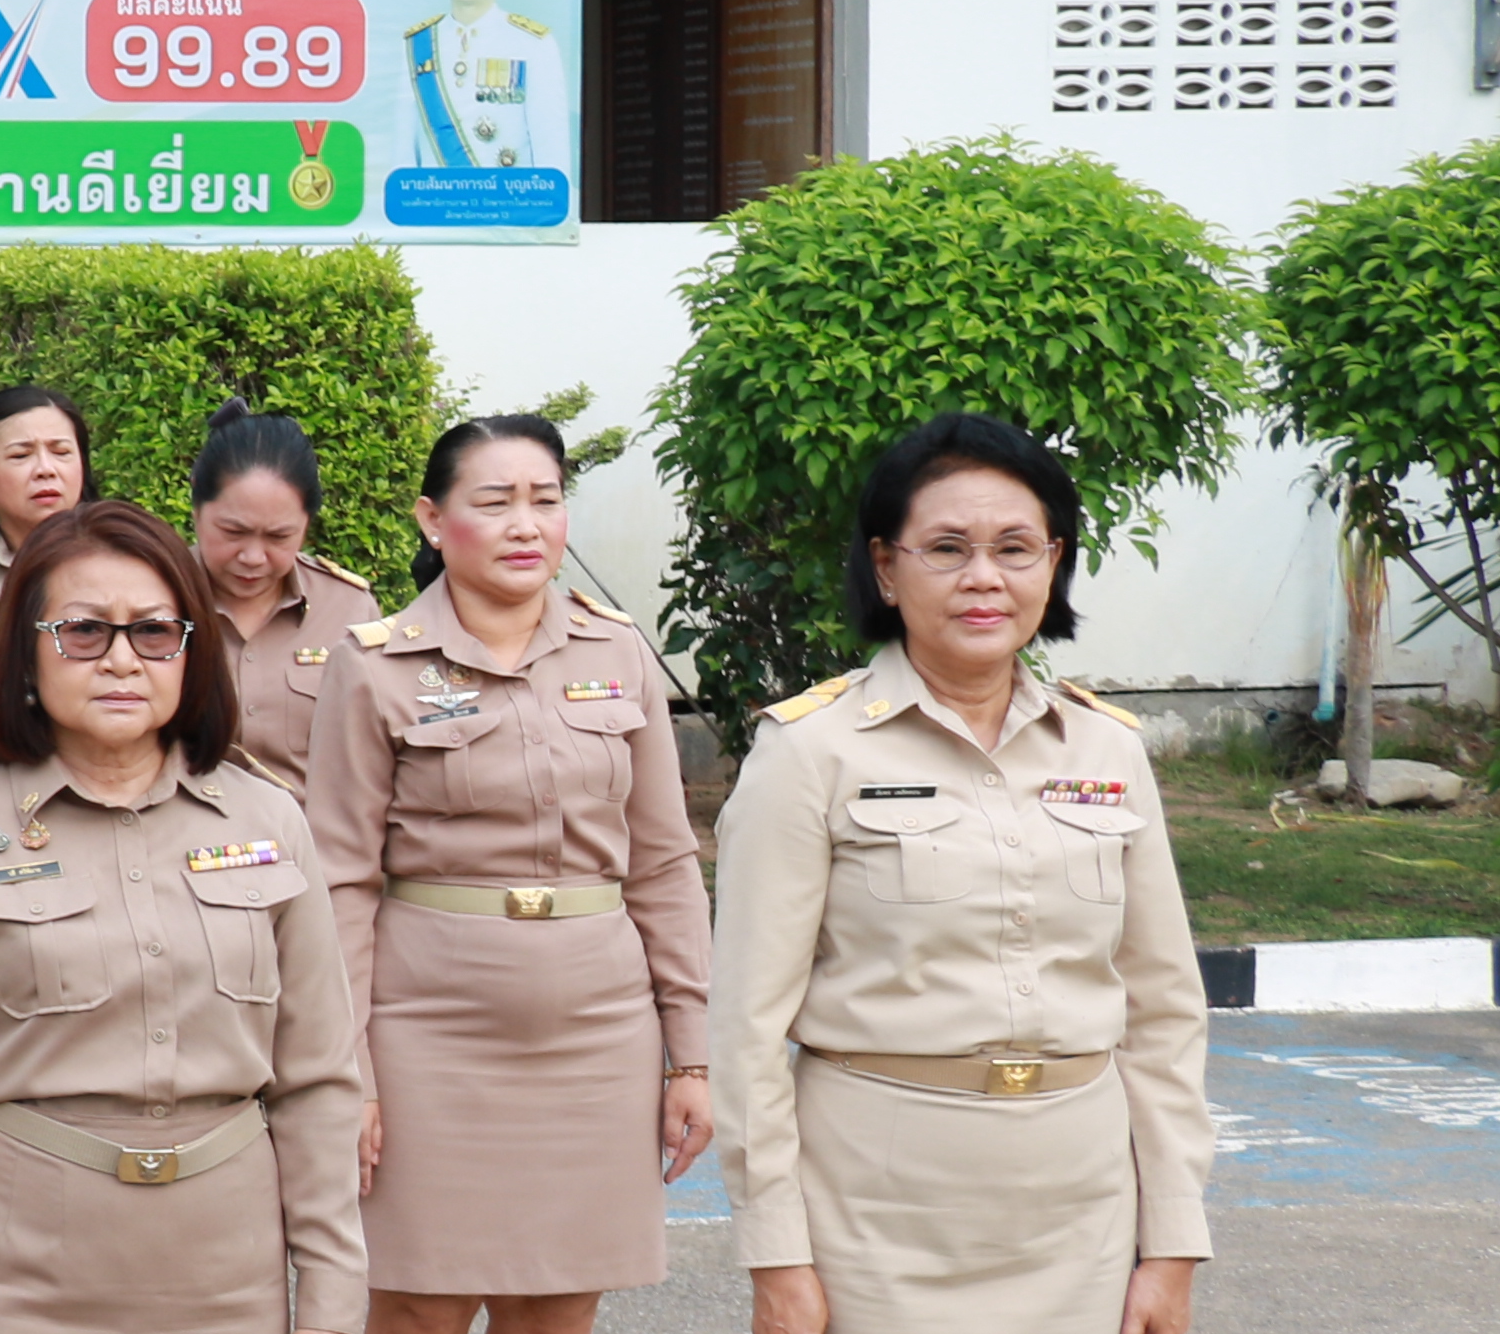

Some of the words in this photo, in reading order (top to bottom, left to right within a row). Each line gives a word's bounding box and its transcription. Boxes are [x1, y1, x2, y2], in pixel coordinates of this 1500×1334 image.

[112, 25, 342, 89] 99.89
[504, 174, 555, 195] บุญเรือง
